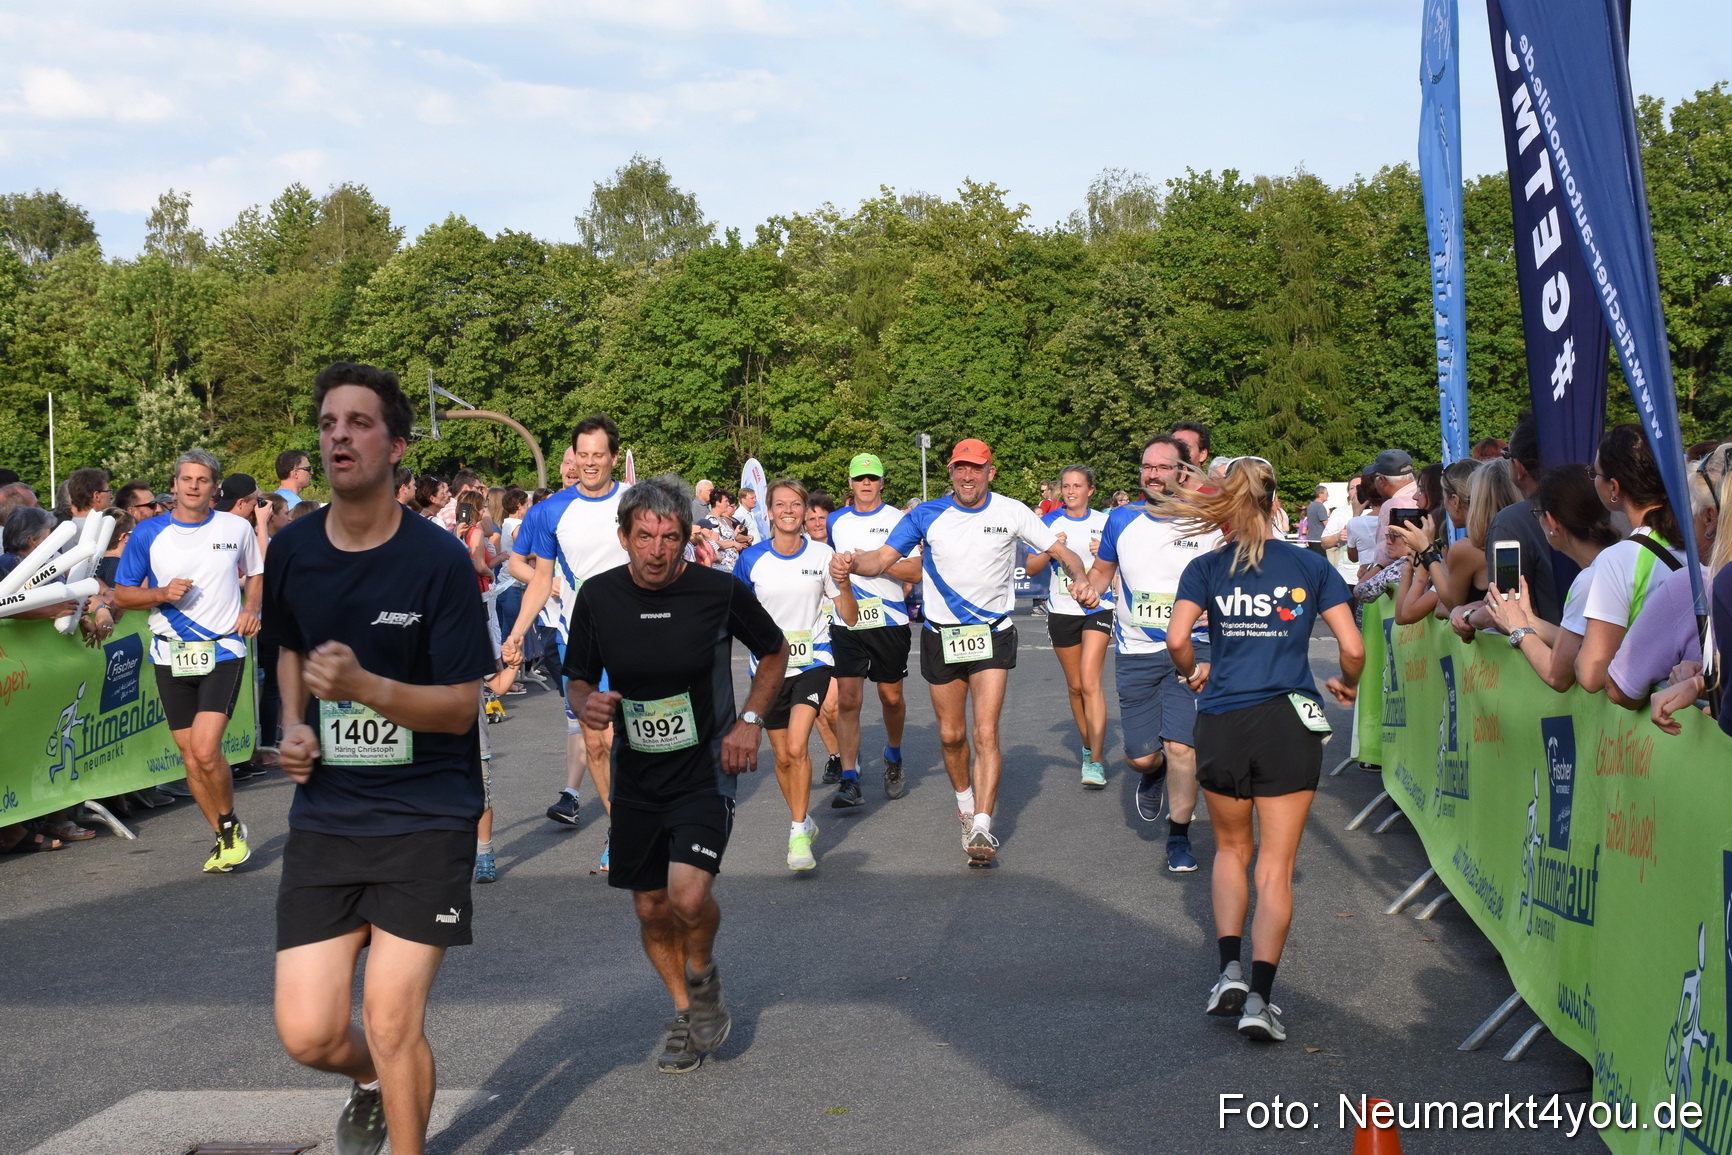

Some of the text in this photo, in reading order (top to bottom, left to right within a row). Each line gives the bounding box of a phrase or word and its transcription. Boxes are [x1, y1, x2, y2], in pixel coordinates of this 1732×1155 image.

[1137, 603, 1173, 619] 1113
[1215, 587, 1272, 617] vhs
[1247, 629, 1277, 637] Neumarkt
[949, 637, 986, 653] 1103
[112, 658, 138, 676] Fischer
[176, 653, 209, 666] 1109
[82, 690, 166, 754] firmenlau
[331, 719, 399, 745] 1402
[632, 715, 686, 738] 1992
[84, 743, 124, 772] neumarkt
[357, 746, 394, 754] Christoph
[1552, 758, 1573, 780] Fischer
[1537, 833, 1600, 924] firmenlauf
